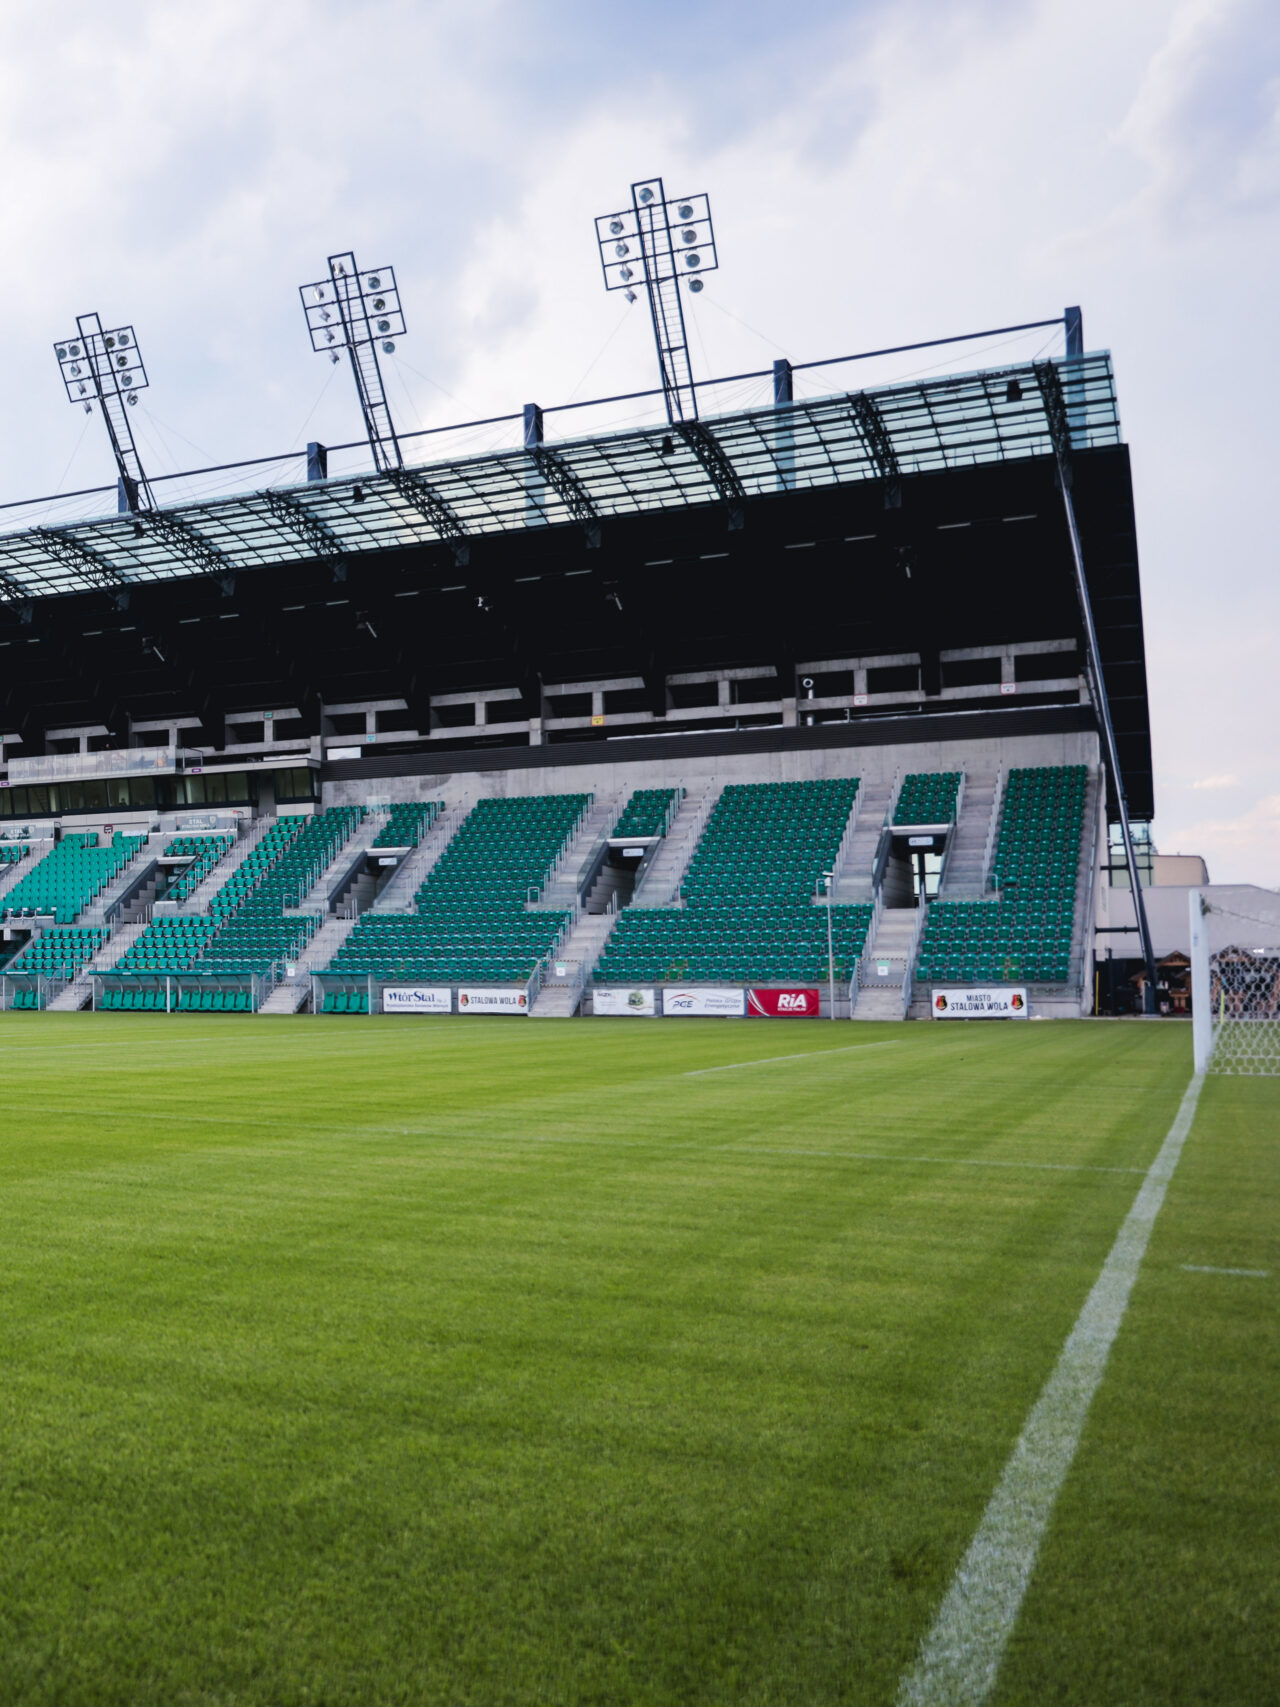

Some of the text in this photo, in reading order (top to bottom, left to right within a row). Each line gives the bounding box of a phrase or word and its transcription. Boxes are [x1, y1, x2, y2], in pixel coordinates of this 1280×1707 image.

[470, 996, 516, 1005] STALOWA WOLA
[672, 1000, 693, 1008] PGE
[777, 993, 807, 1008] RiA
[950, 1002, 1008, 1011] STALOWA WOLA
